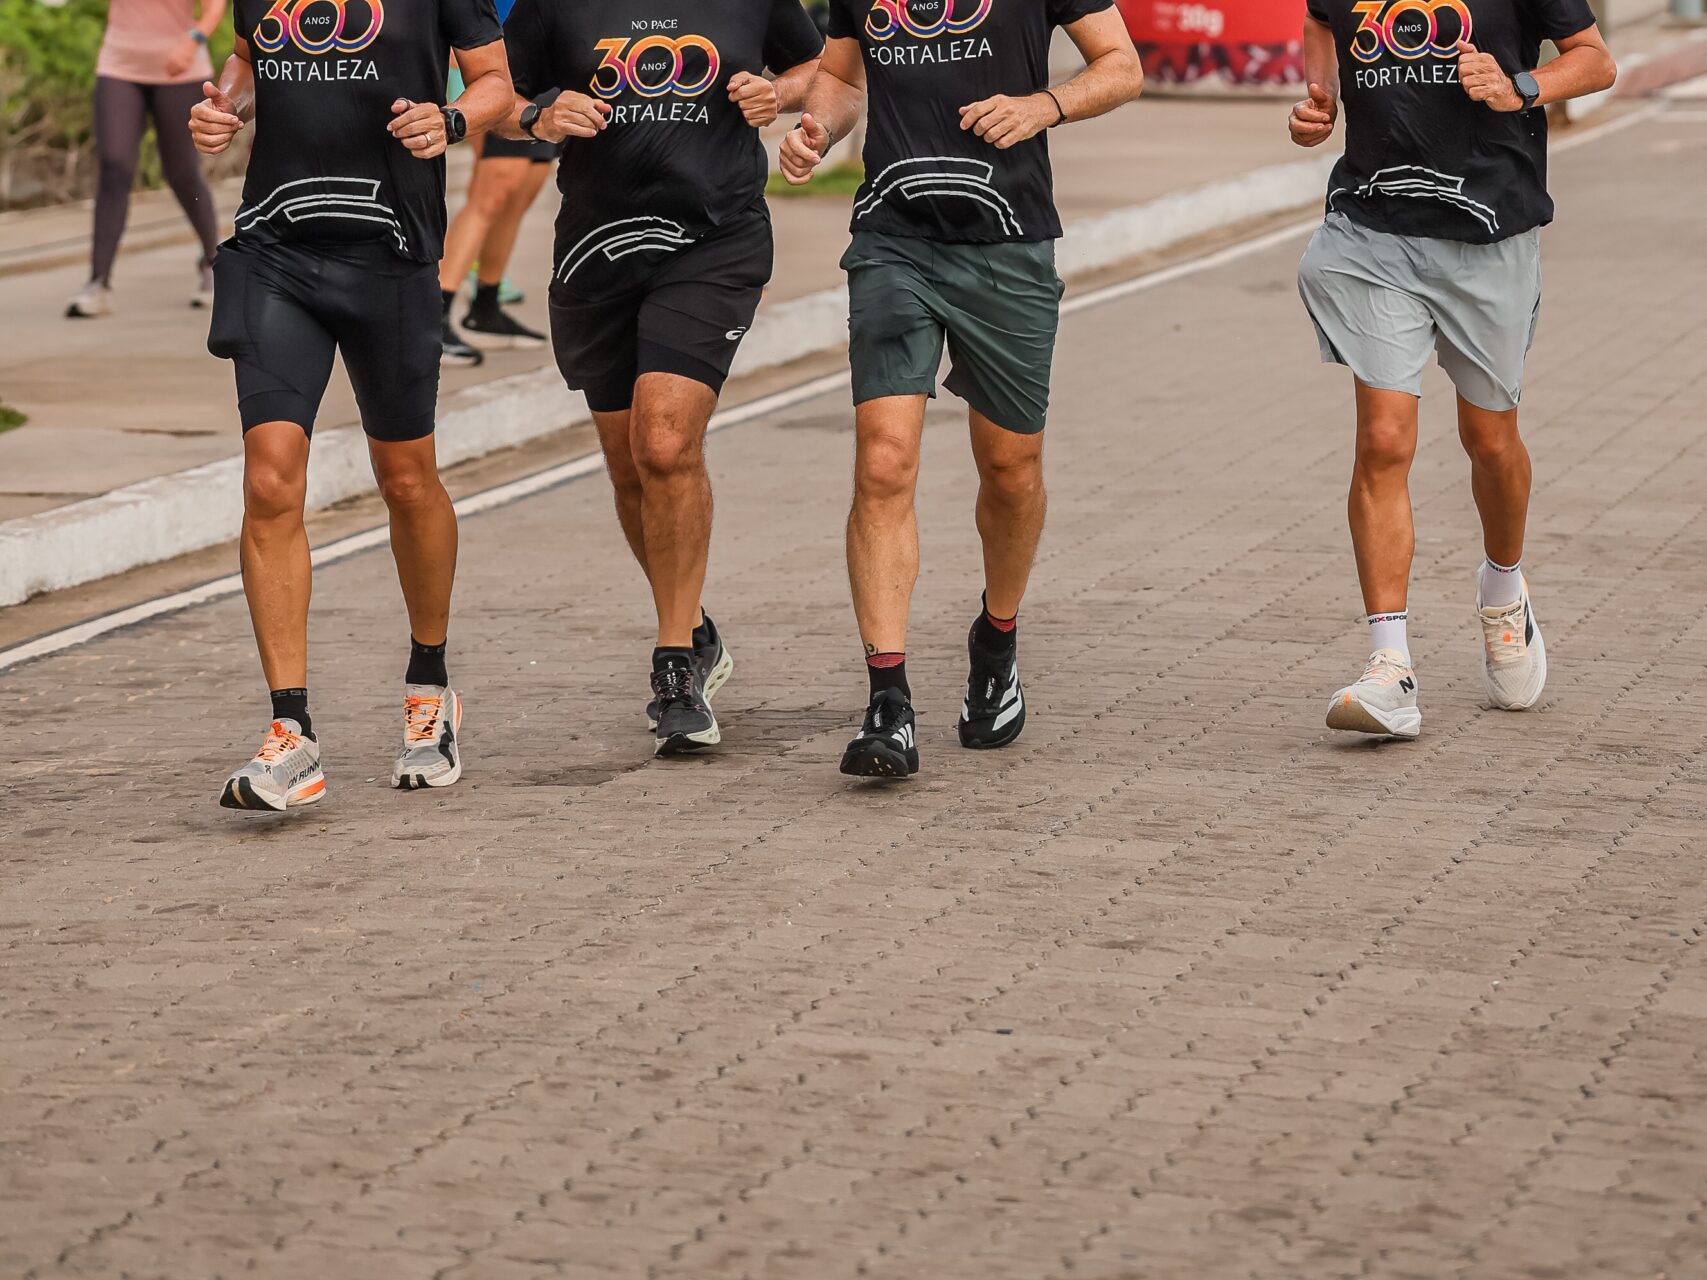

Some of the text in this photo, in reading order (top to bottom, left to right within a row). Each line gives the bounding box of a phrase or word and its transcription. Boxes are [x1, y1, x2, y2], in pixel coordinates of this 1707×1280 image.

[912, 1, 939, 11] ANOS
[304, 16, 330, 25] ANOS
[631, 19, 678, 30] NO PACE
[1397, 24, 1422, 33] ANOS
[869, 37, 993, 66] FORTALEZA
[257, 59, 379, 81] FORTALEZA
[589, 34, 721, 99] 300
[641, 62, 666, 71] ANOS
[1355, 64, 1461, 89] FORTALEZ
[602, 102, 709, 125] ORTALEZA
